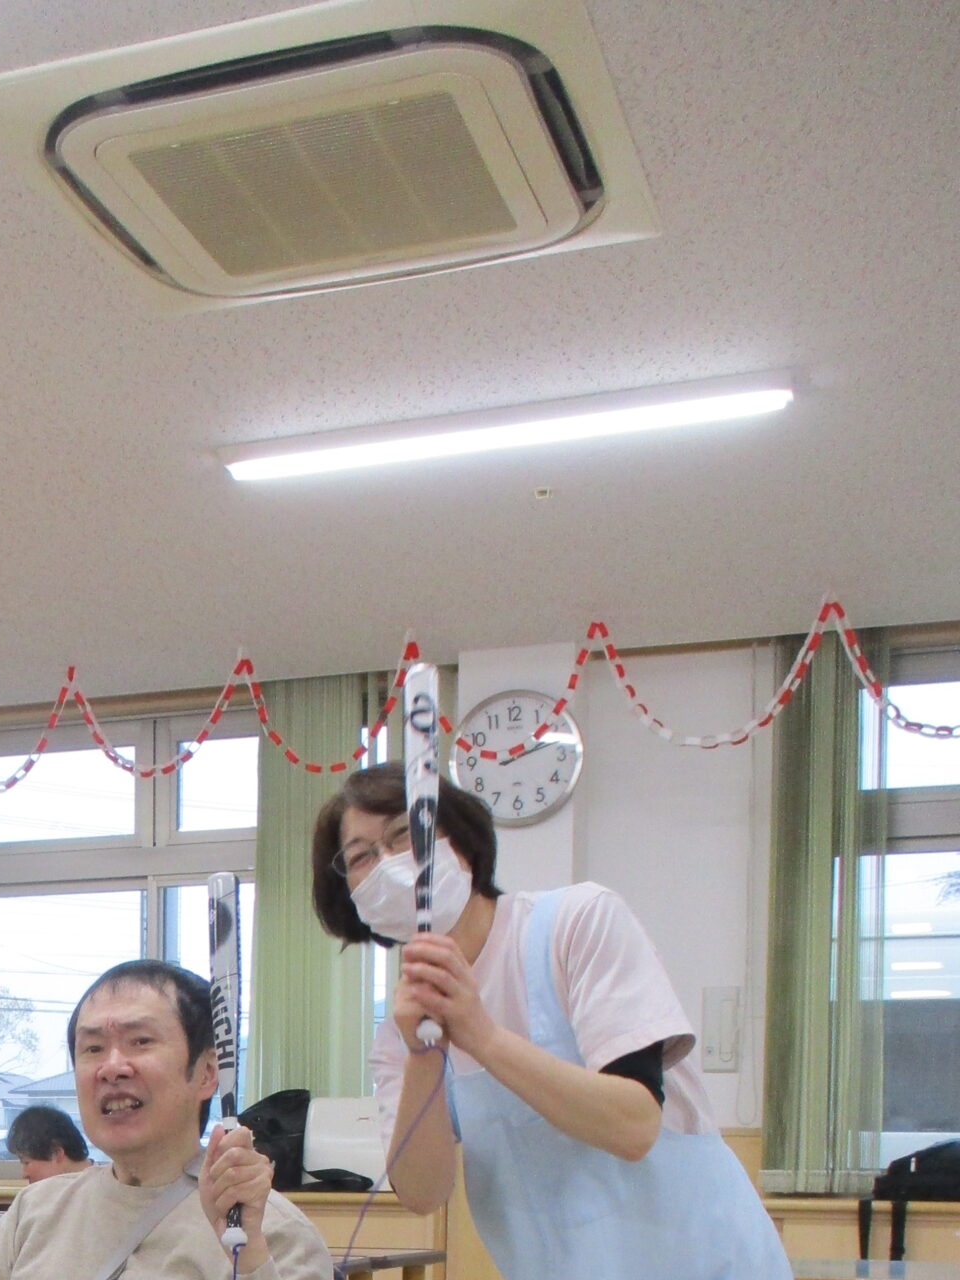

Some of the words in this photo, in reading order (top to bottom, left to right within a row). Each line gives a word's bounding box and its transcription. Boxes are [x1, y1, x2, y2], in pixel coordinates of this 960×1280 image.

[507, 706, 522, 722] 12
[534, 709, 540, 723] 1
[488, 715, 499, 730] 11
[472, 732, 487, 748] 10
[556, 746, 567, 762] 3
[467, 757, 477, 771] 9
[549, 770, 561, 783] 4
[474, 777, 485, 792] 8
[492, 792, 501, 806] 7
[536, 788, 545, 803] 5
[513, 796, 524, 811] 6
